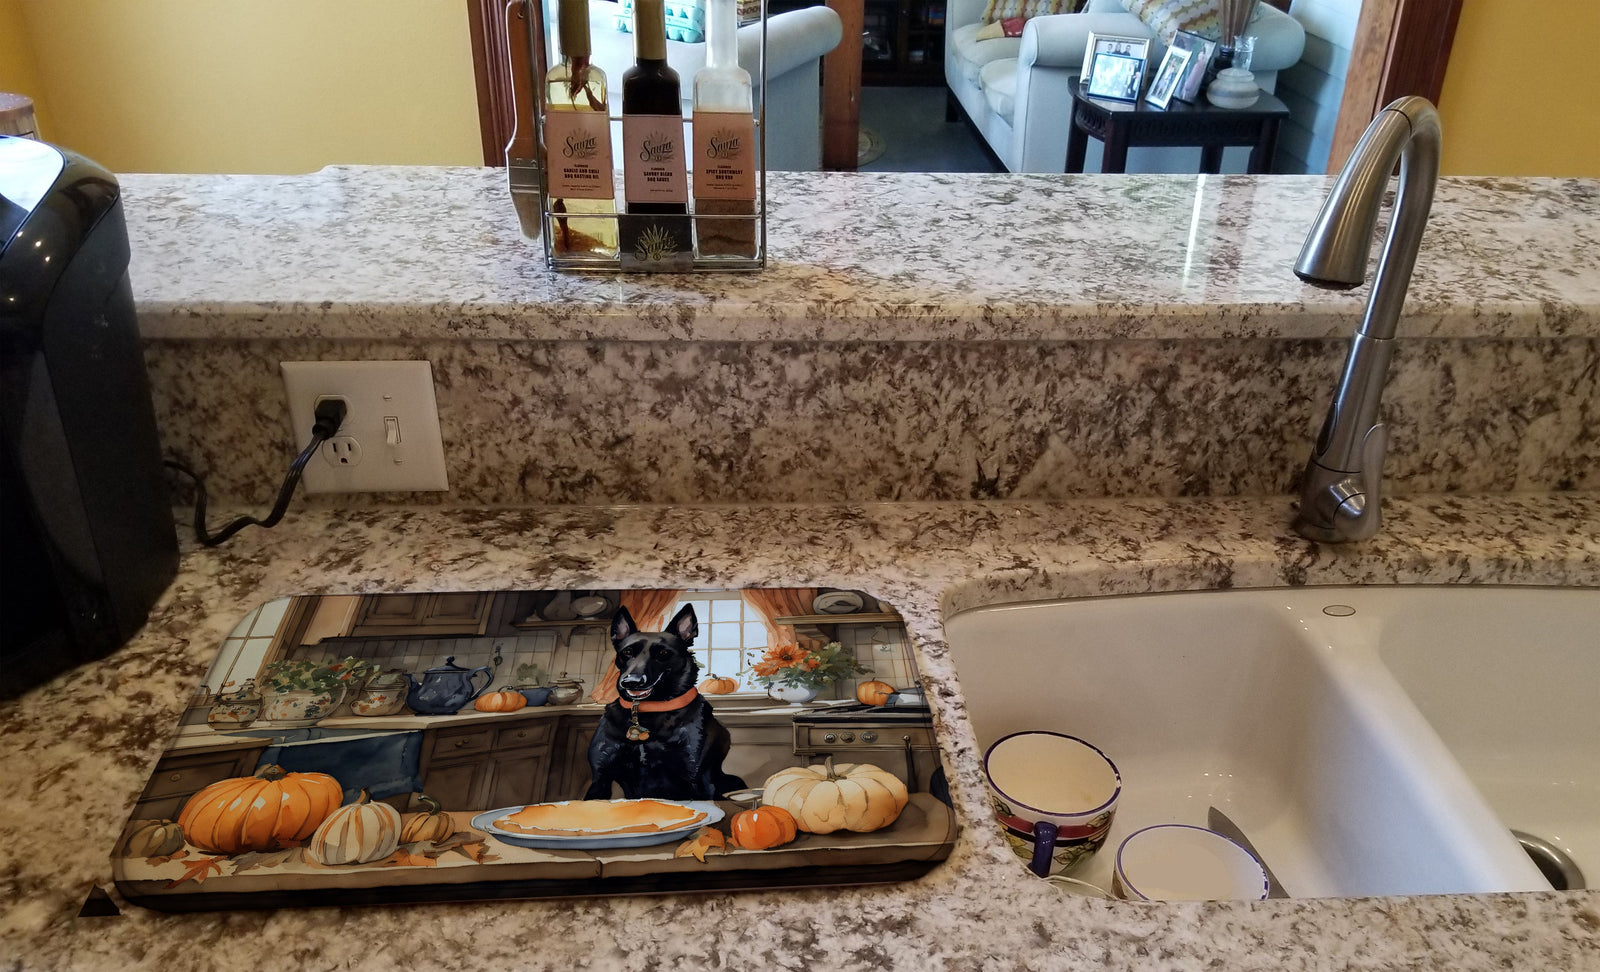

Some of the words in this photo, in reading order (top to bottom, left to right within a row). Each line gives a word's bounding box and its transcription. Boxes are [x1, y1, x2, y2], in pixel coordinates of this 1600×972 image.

[563, 136, 597, 158] Sauza
[640, 140, 673, 161] Sauza
[707, 137, 739, 158] Sauza
